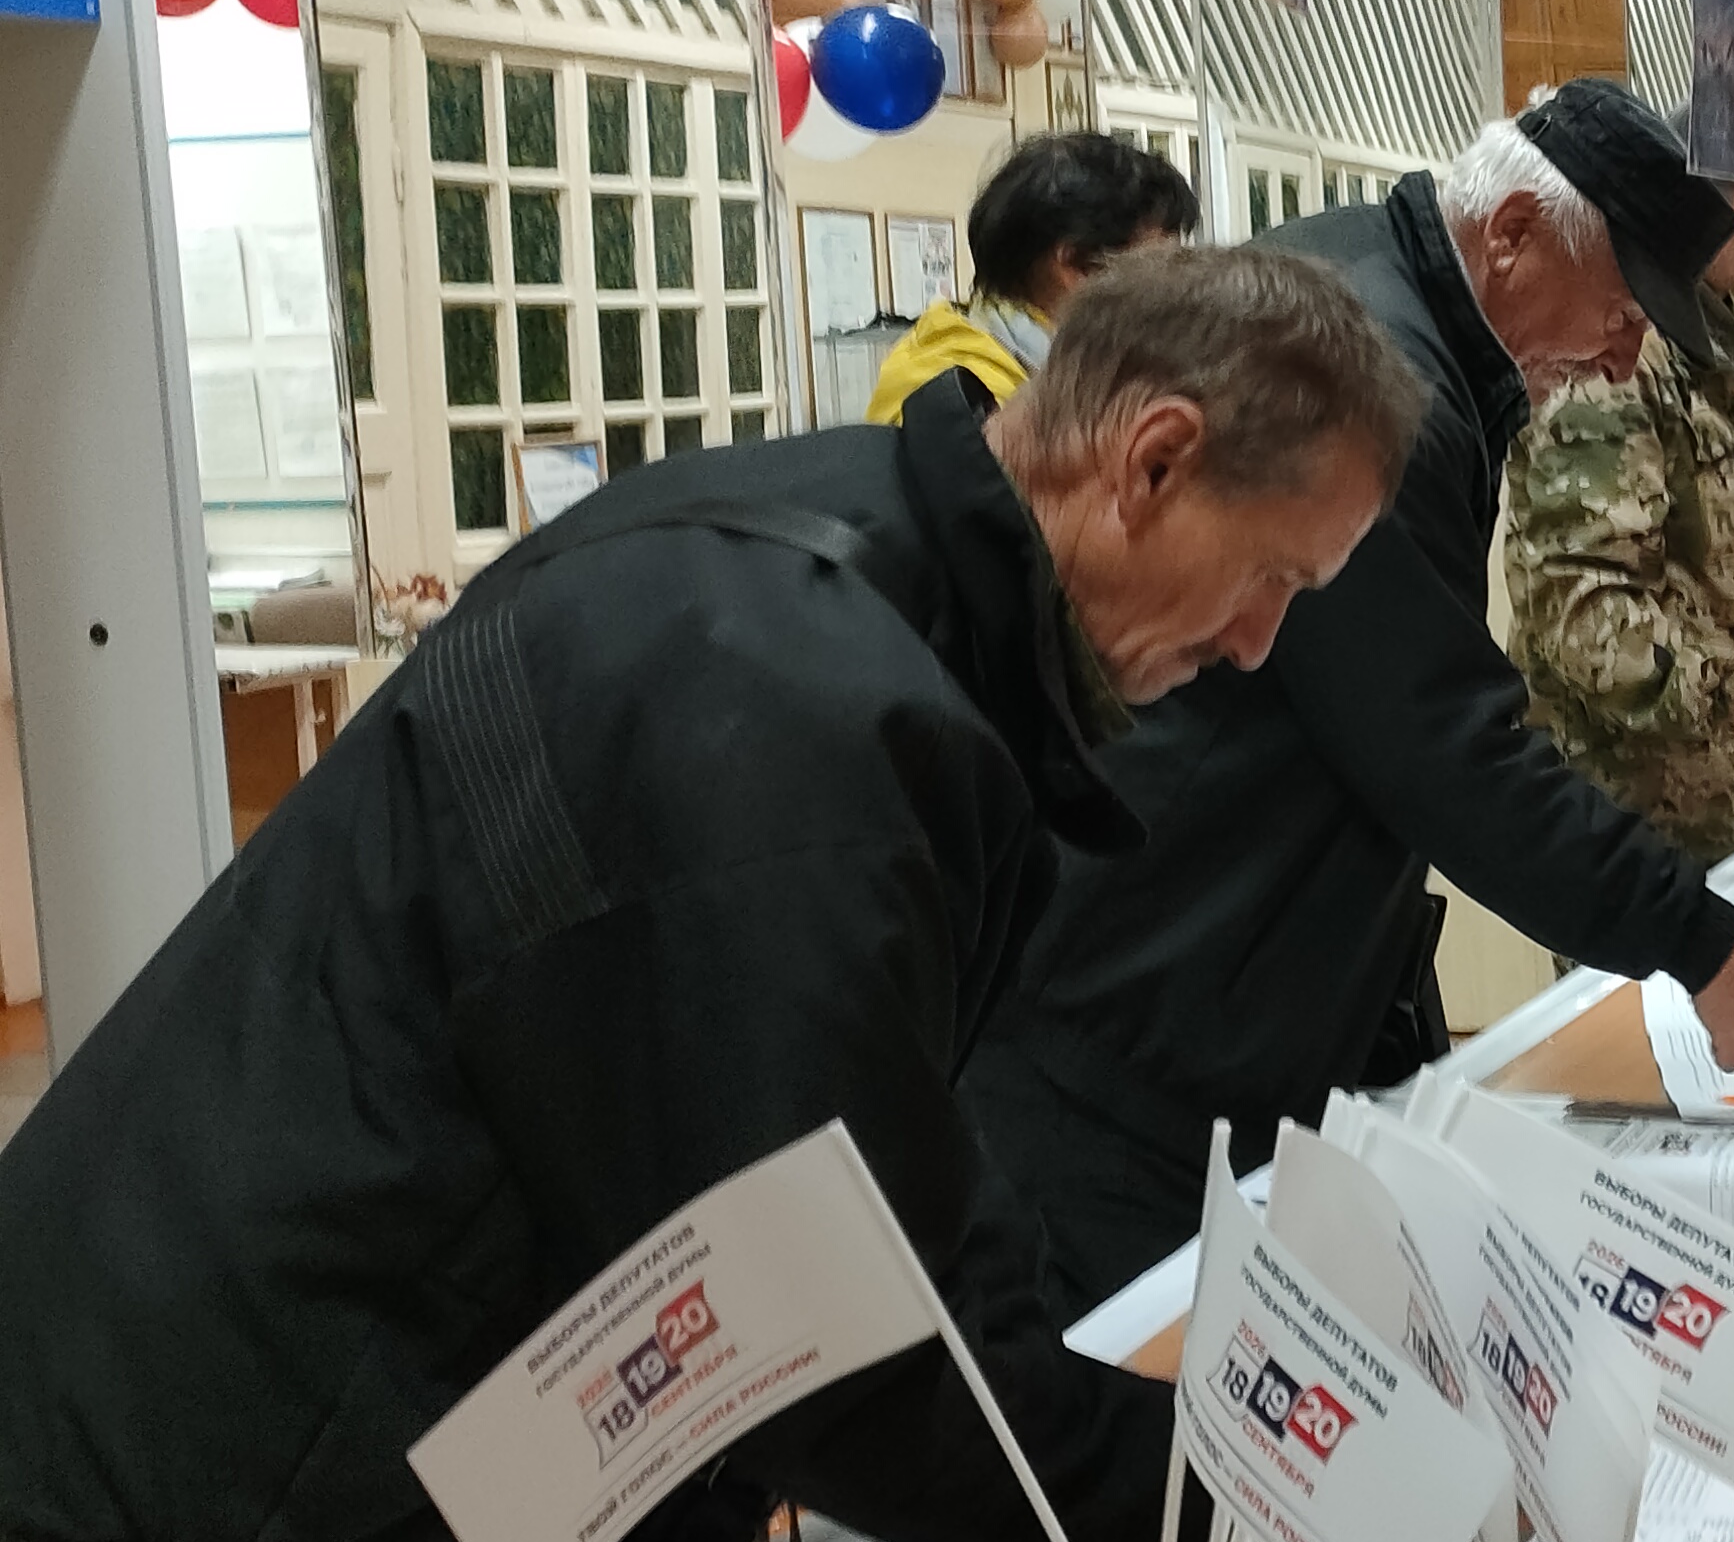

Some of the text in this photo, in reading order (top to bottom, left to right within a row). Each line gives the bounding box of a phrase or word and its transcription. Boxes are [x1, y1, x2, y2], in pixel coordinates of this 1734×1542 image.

[1594, 1169, 1667, 1223] ВЫБОРЫ
[1254, 1239, 1399, 1393] ВЫБОРЫ ДЕПУТАТОВ
[1620, 1279, 1658, 1323] 19
[1664, 1290, 1713, 1339] 20
[598, 1298, 708, 1444] 18 19 20
[1221, 1357, 1249, 1405] 18
[1256, 1370, 1291, 1423] 19
[1295, 1393, 1341, 1449] 20
[1482, 1332, 1501, 1375] 18
[1527, 1375, 1551, 1426] 20
